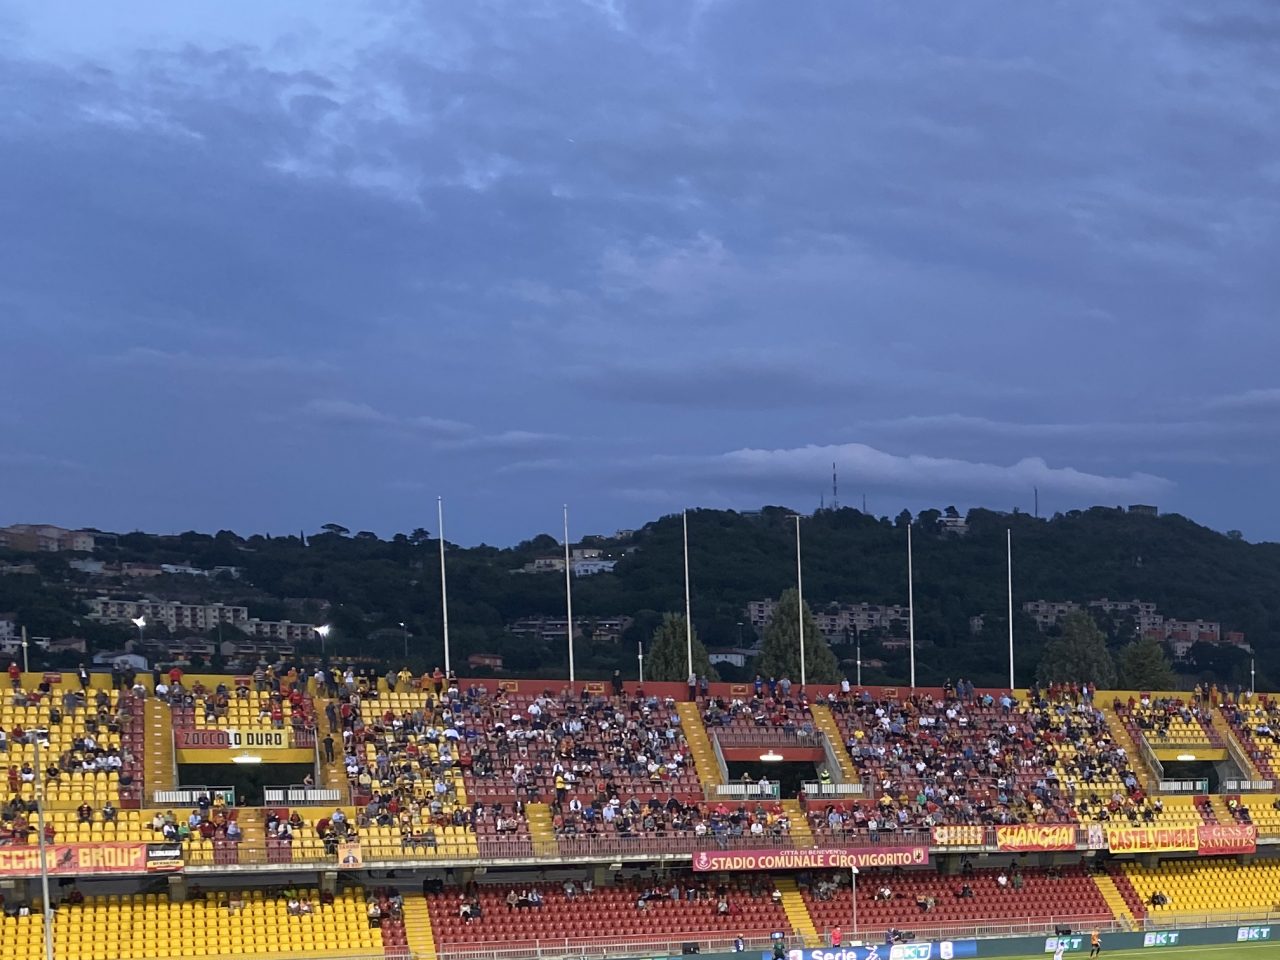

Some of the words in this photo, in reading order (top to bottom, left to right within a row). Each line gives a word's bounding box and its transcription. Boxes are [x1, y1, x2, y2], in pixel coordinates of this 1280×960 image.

[183, 732, 241, 746] ZOCCOLO
[247, 732, 282, 746] DURO
[997, 826, 1074, 848] SHANGHAI
[1212, 827, 1241, 837] GENS
[1200, 837, 1255, 849] SAMNITES
[78, 847, 142, 868] GROUP
[711, 857, 756, 870] STADIO
[758, 855, 825, 869] COMUNALE
[828, 854, 856, 867] CIRO
[857, 852, 912, 866] VIGORITO
[1144, 930, 1179, 948] BKT
[1237, 926, 1271, 942] BKT
